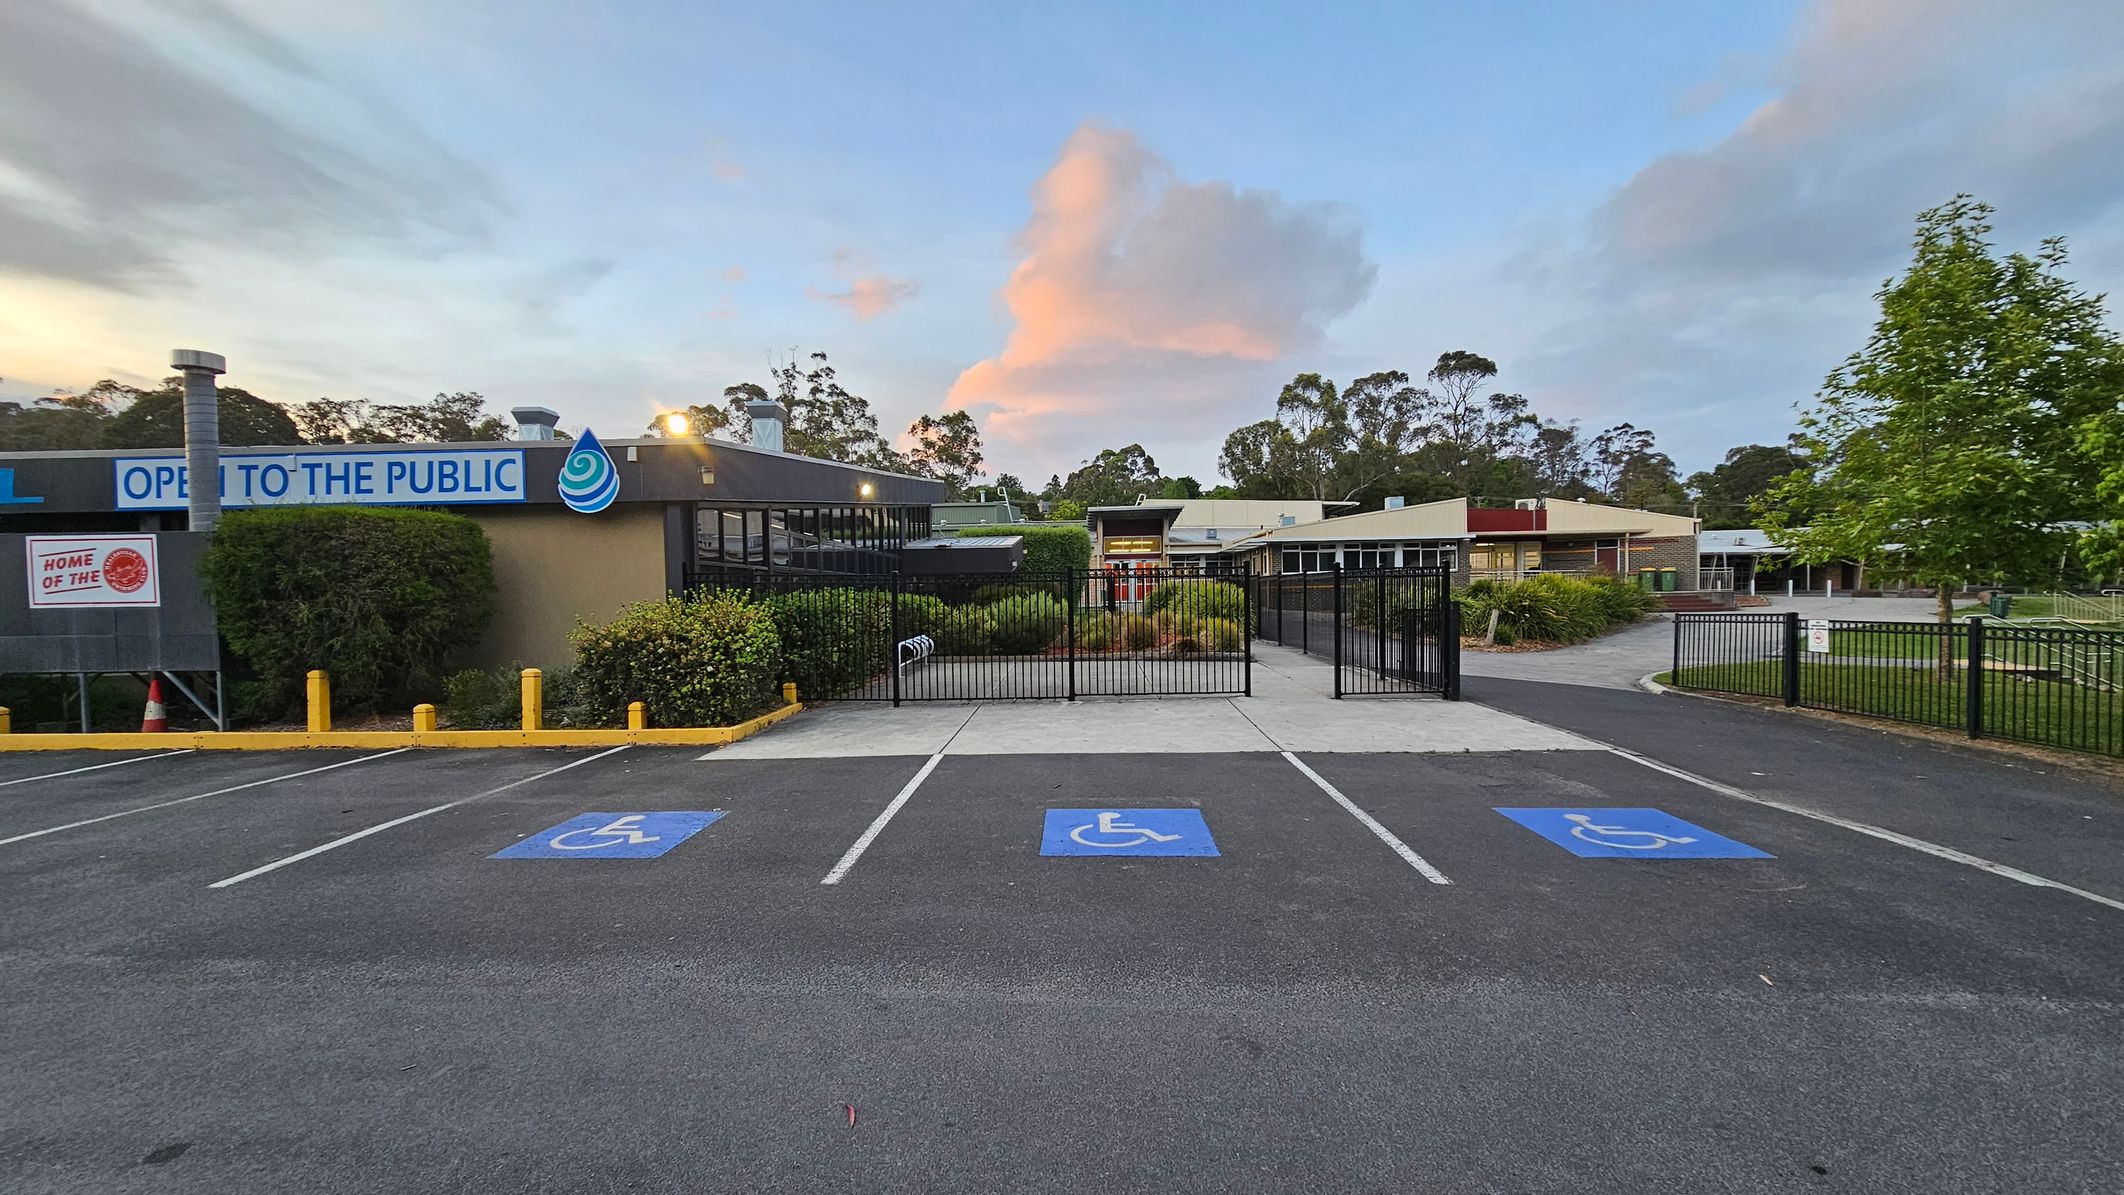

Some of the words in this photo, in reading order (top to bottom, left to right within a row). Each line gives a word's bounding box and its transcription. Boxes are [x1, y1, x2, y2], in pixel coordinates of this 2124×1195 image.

[123, 464, 225, 500] OPE
[237, 463, 289, 497] TO
[301, 461, 374, 496] THE
[387, 458, 517, 494] PUBLIC
[43, 553, 94, 571] HOME
[42, 575, 63, 589] OF
[69, 570, 100, 586] THE
